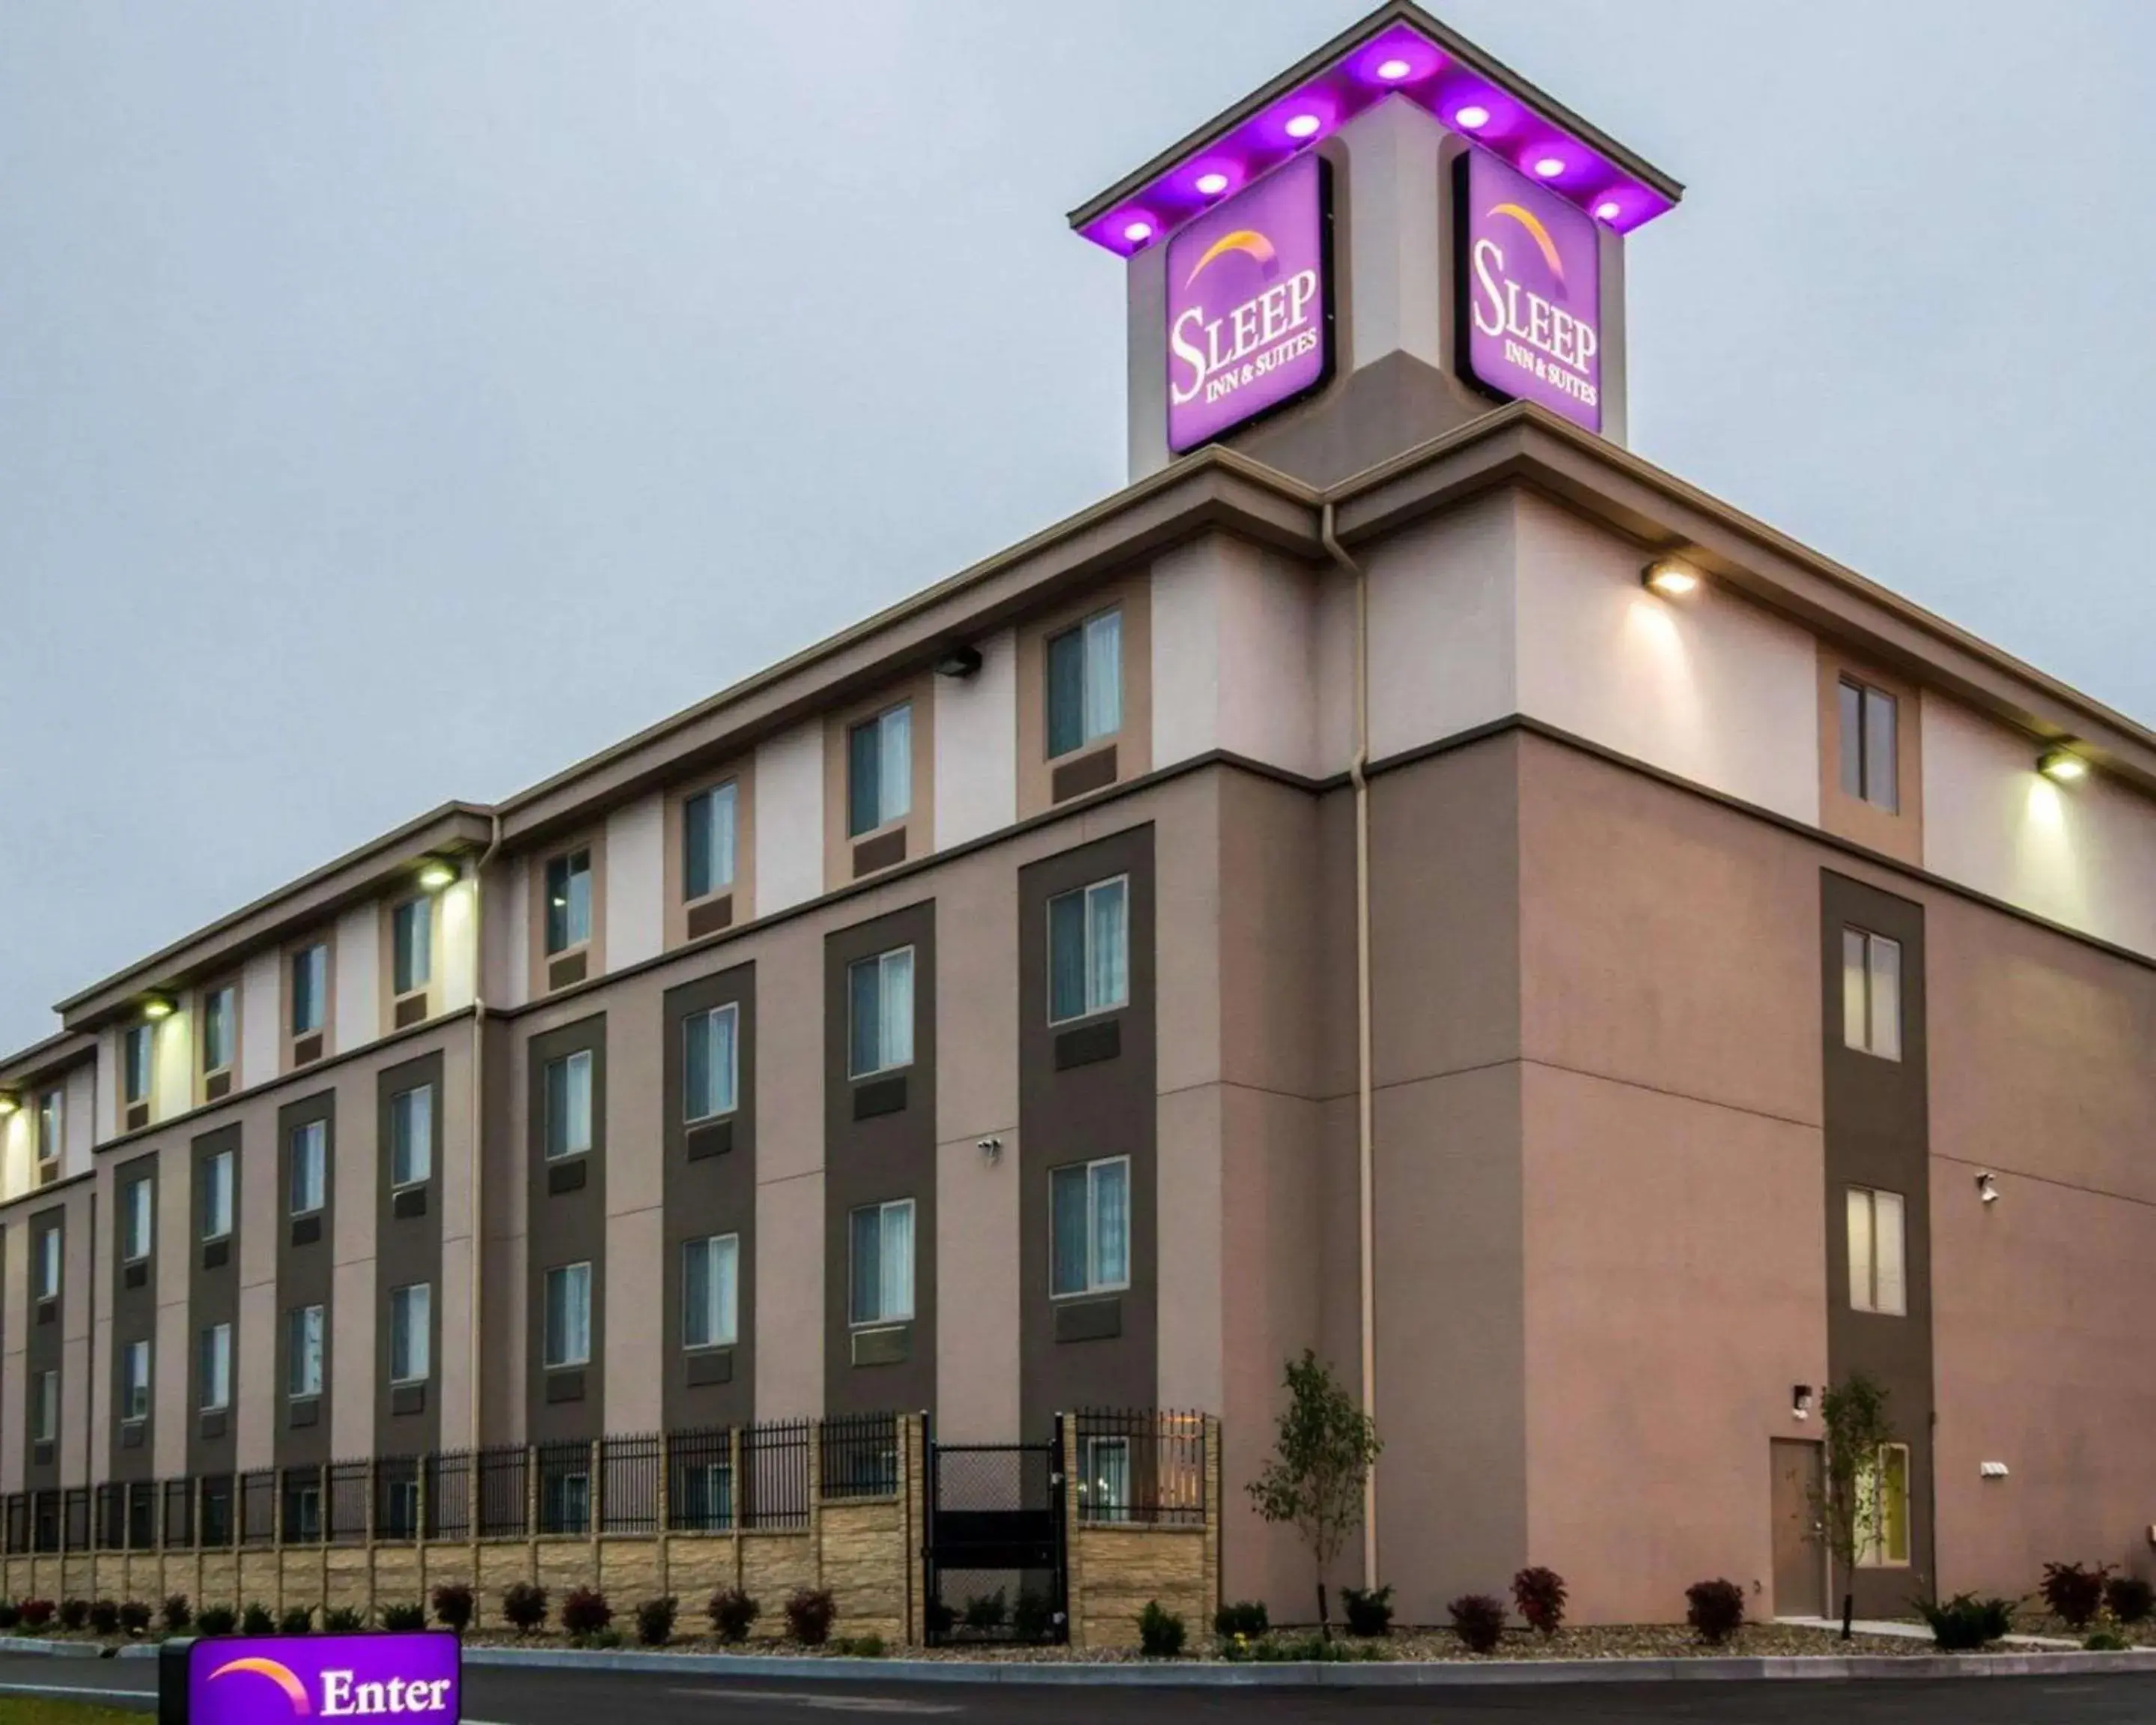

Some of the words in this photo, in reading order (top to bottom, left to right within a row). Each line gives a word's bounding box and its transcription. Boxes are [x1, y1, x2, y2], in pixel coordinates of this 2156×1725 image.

[1172, 270, 1316, 404] SLEEP
[1474, 239, 1597, 374] SLEEP
[1205, 368, 1238, 404] INN
[1240, 364, 1254, 385] &
[1256, 326, 1318, 377] SUITES
[1504, 338, 1535, 371] INN
[1535, 358, 1547, 379] &
[1547, 362, 1597, 406] SUITES
[319, 1669, 451, 1716] Enter
